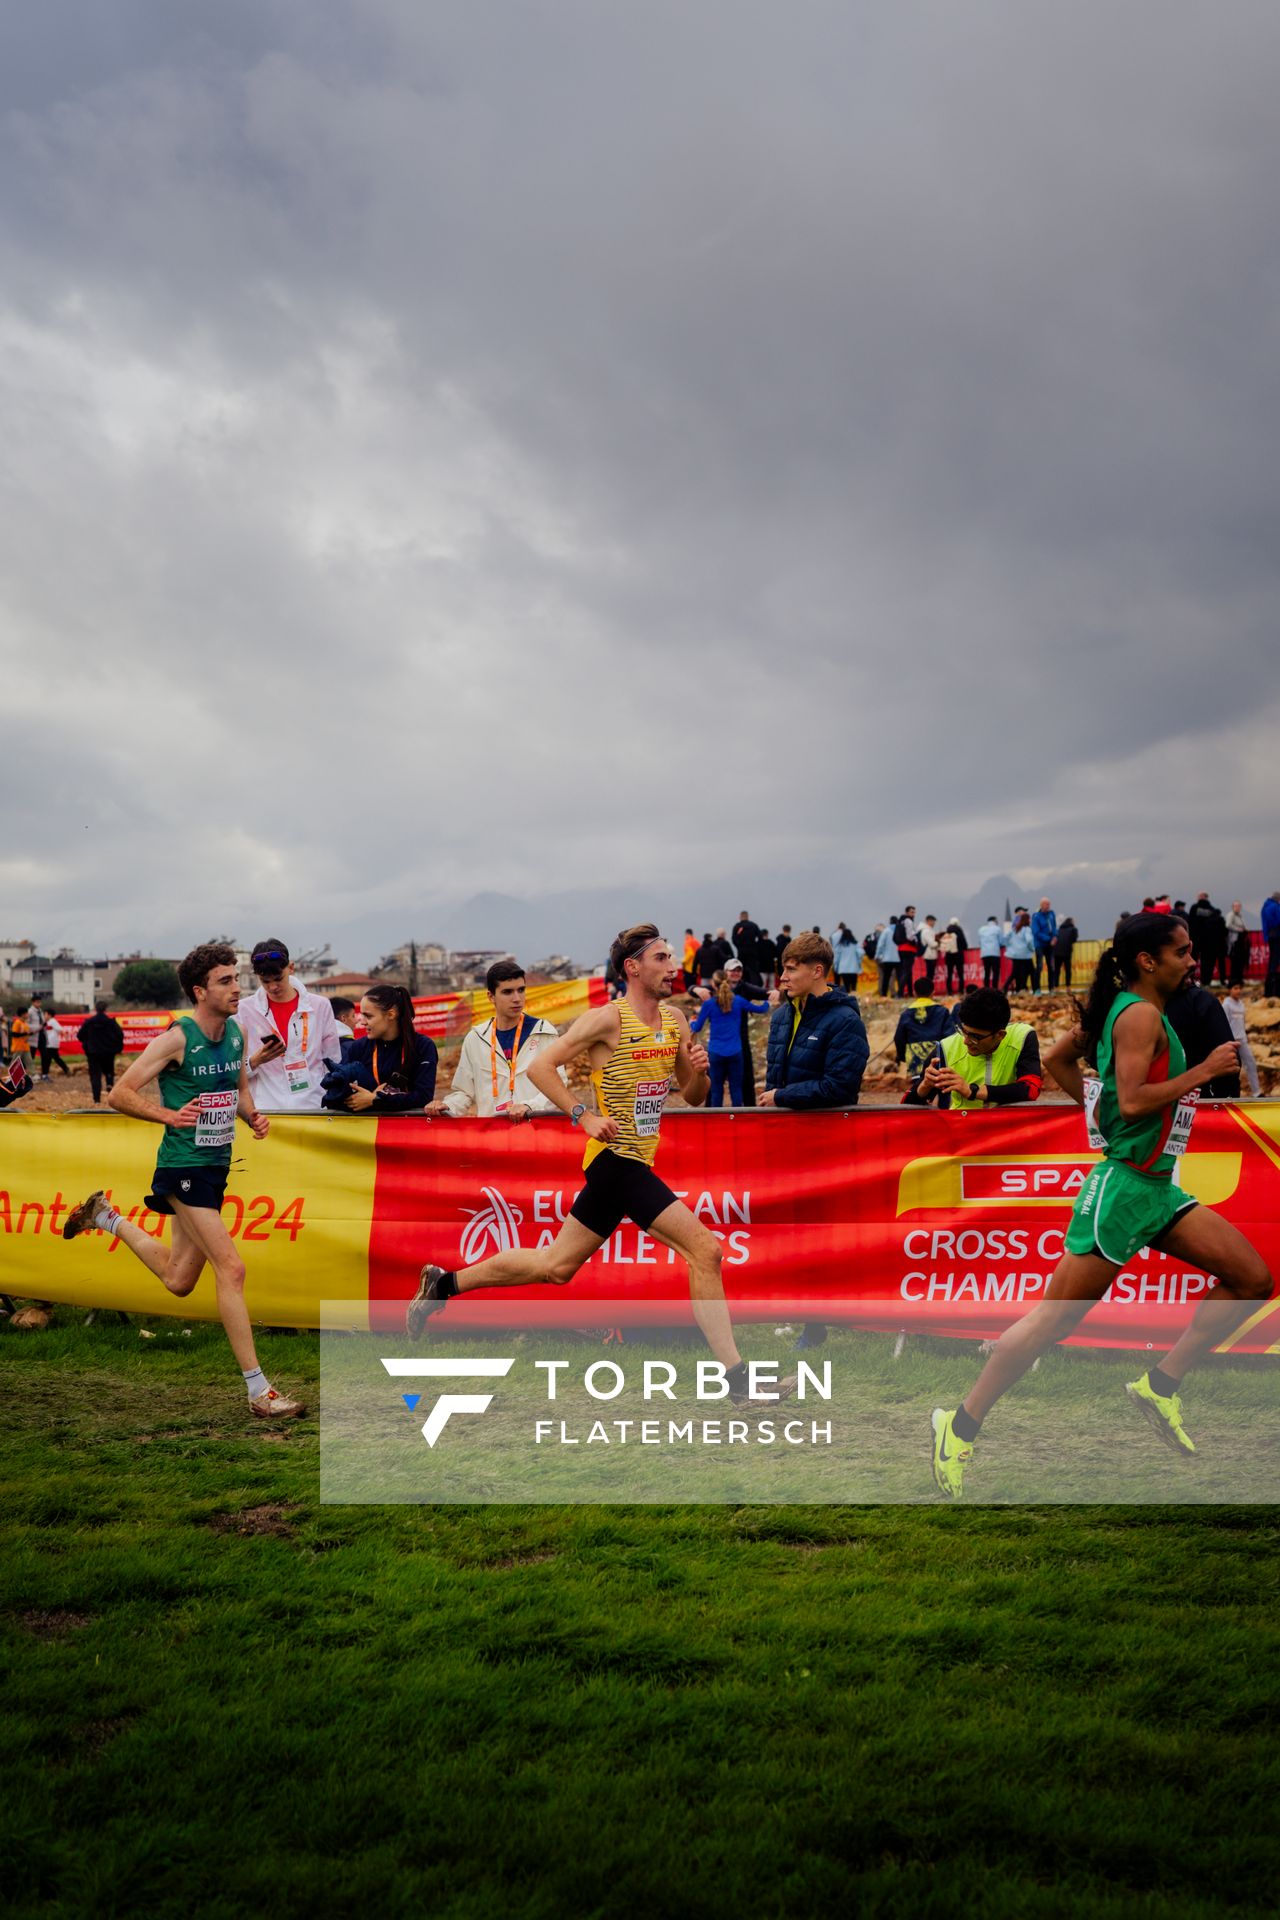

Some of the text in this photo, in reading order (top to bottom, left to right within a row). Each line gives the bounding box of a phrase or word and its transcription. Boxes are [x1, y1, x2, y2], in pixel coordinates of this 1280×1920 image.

[192, 1060, 242, 1076] IRELAND
[201, 1094, 232, 1107] SPAR
[635, 1100, 663, 1115] BIENE
[1001, 1169, 1087, 1192] SPA
[534, 1190, 752, 1224] EUAN
[1080, 1174, 1100, 1216] PORTUGAL
[0, 1189, 305, 1252] Antya 024
[903, 1229, 1028, 1260] CROSS
